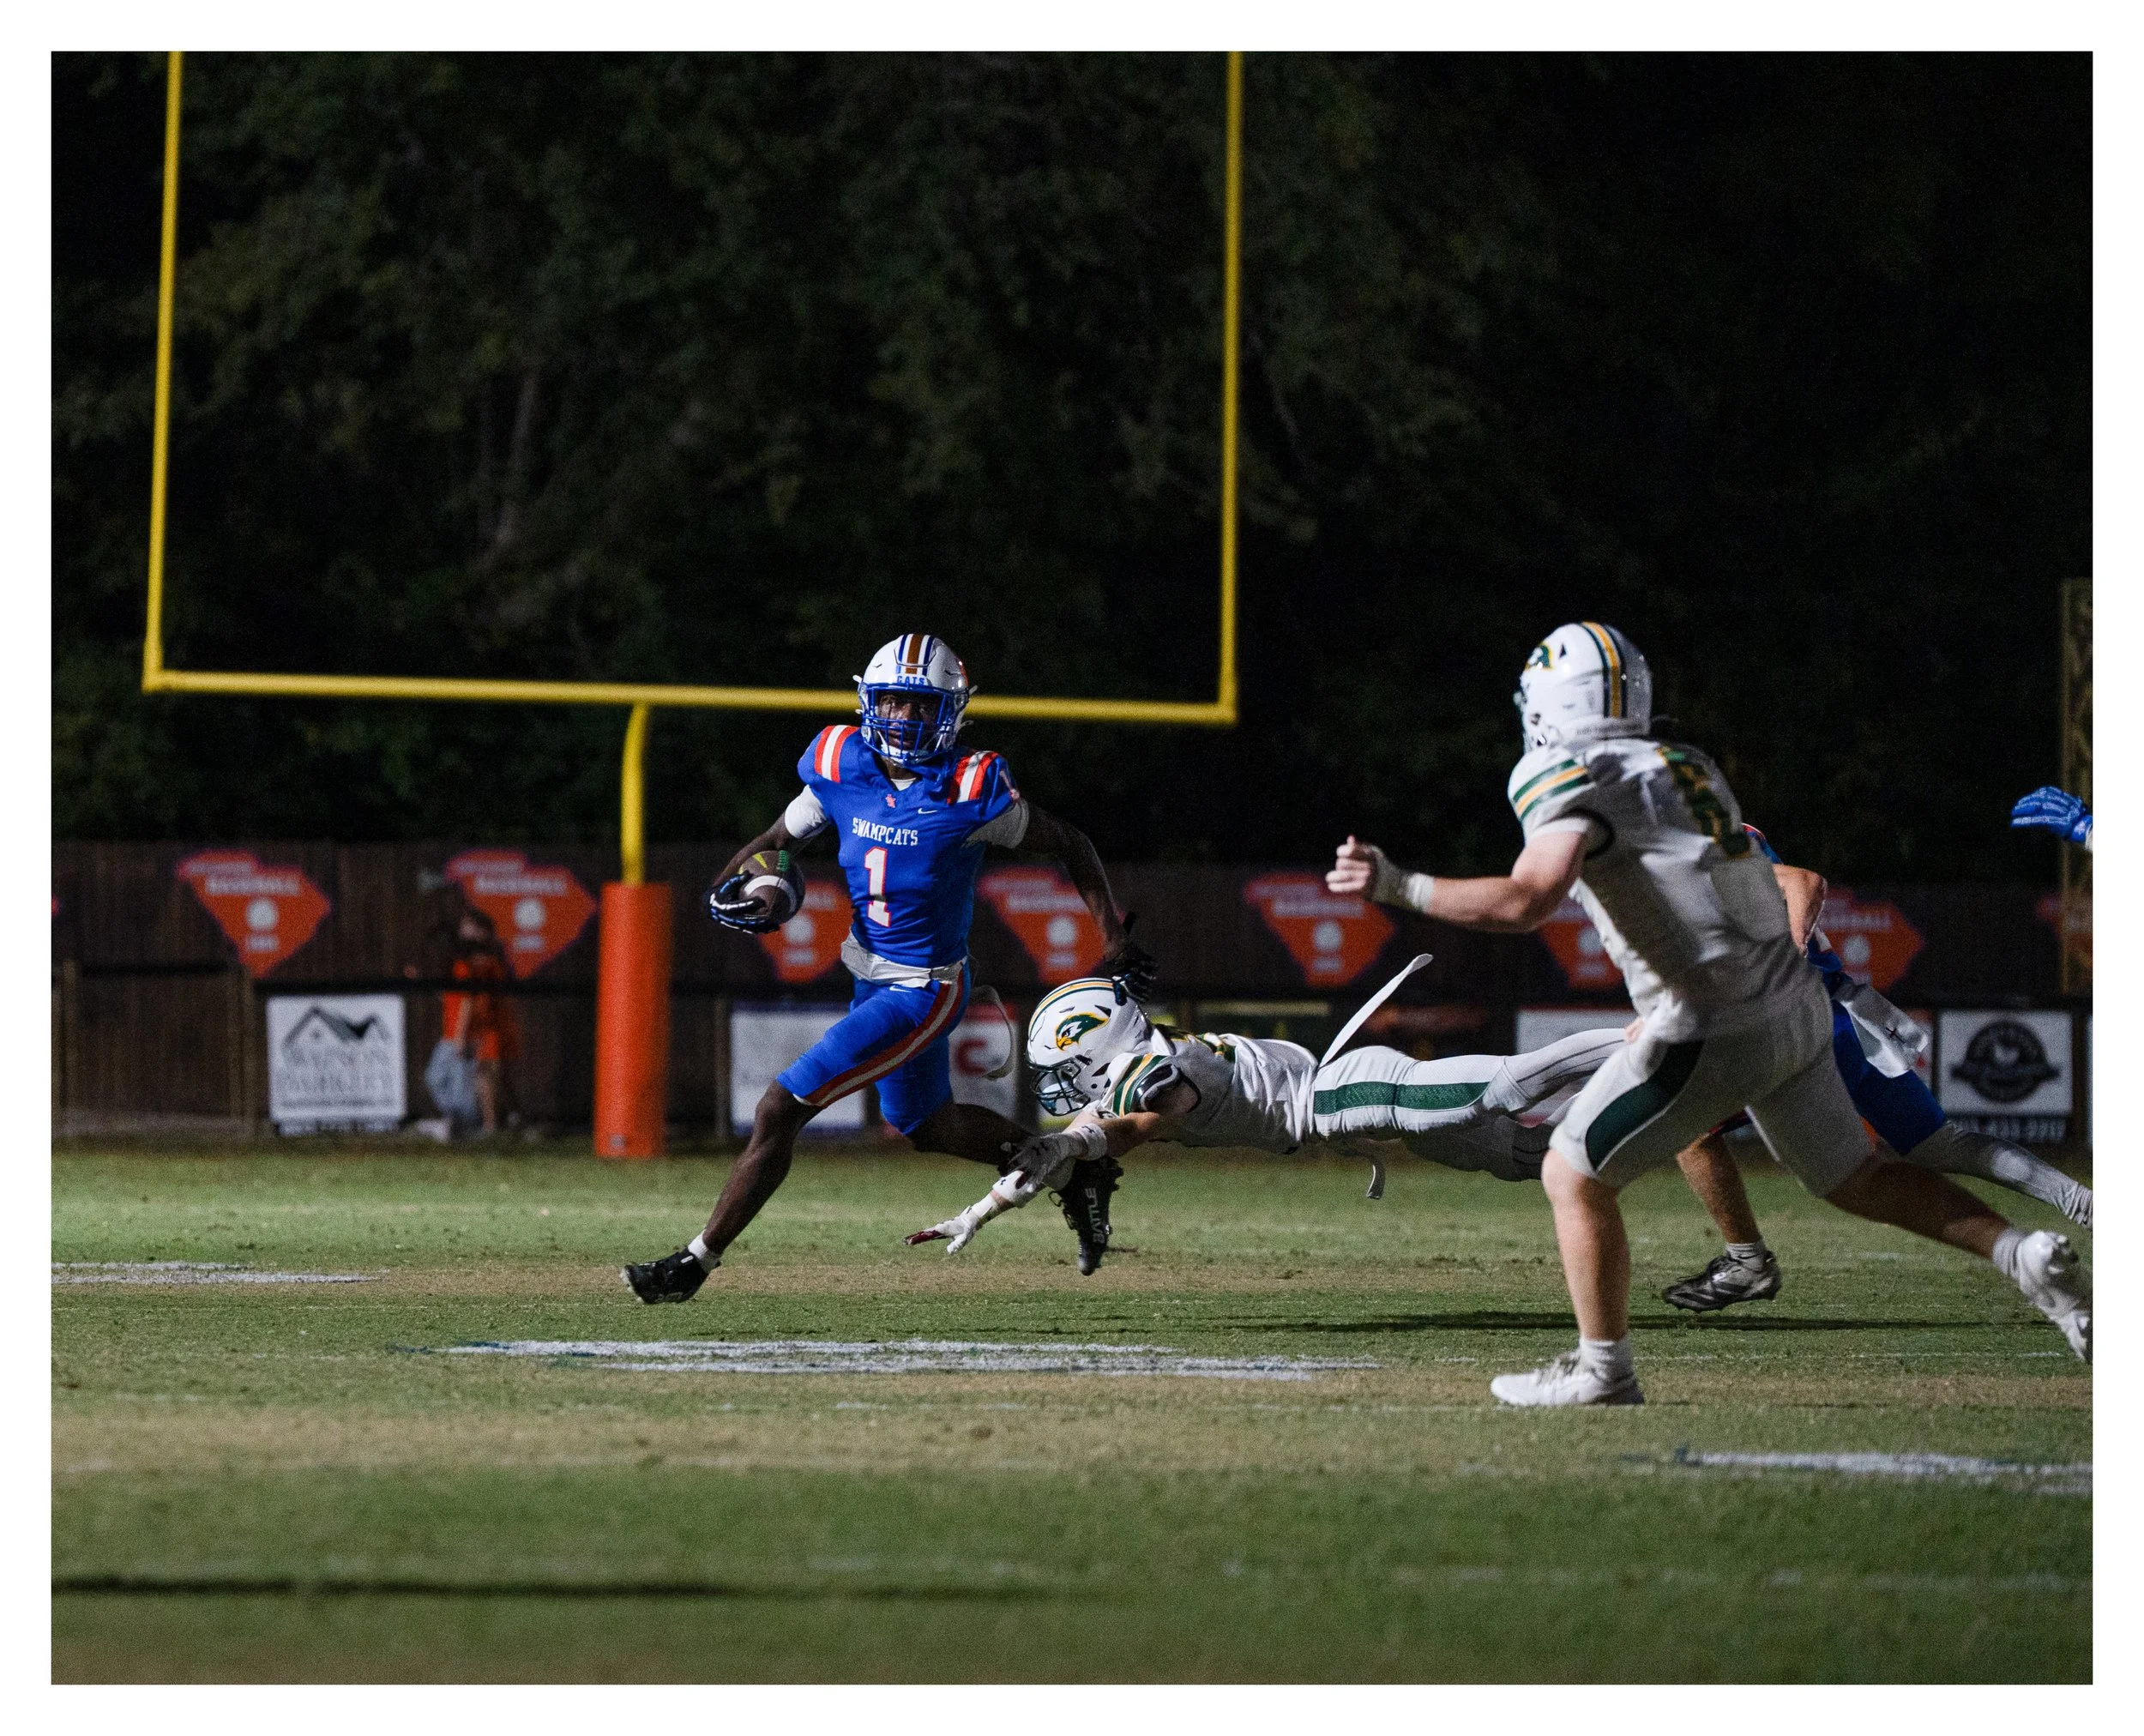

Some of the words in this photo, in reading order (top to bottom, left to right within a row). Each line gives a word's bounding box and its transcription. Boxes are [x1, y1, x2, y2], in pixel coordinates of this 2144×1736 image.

[896, 674, 925, 685] CATS
[852, 817, 918, 847] SWAMPCATS
[864, 845, 892, 928] 1
[1084, 1187, 1105, 1244] BATTLE
